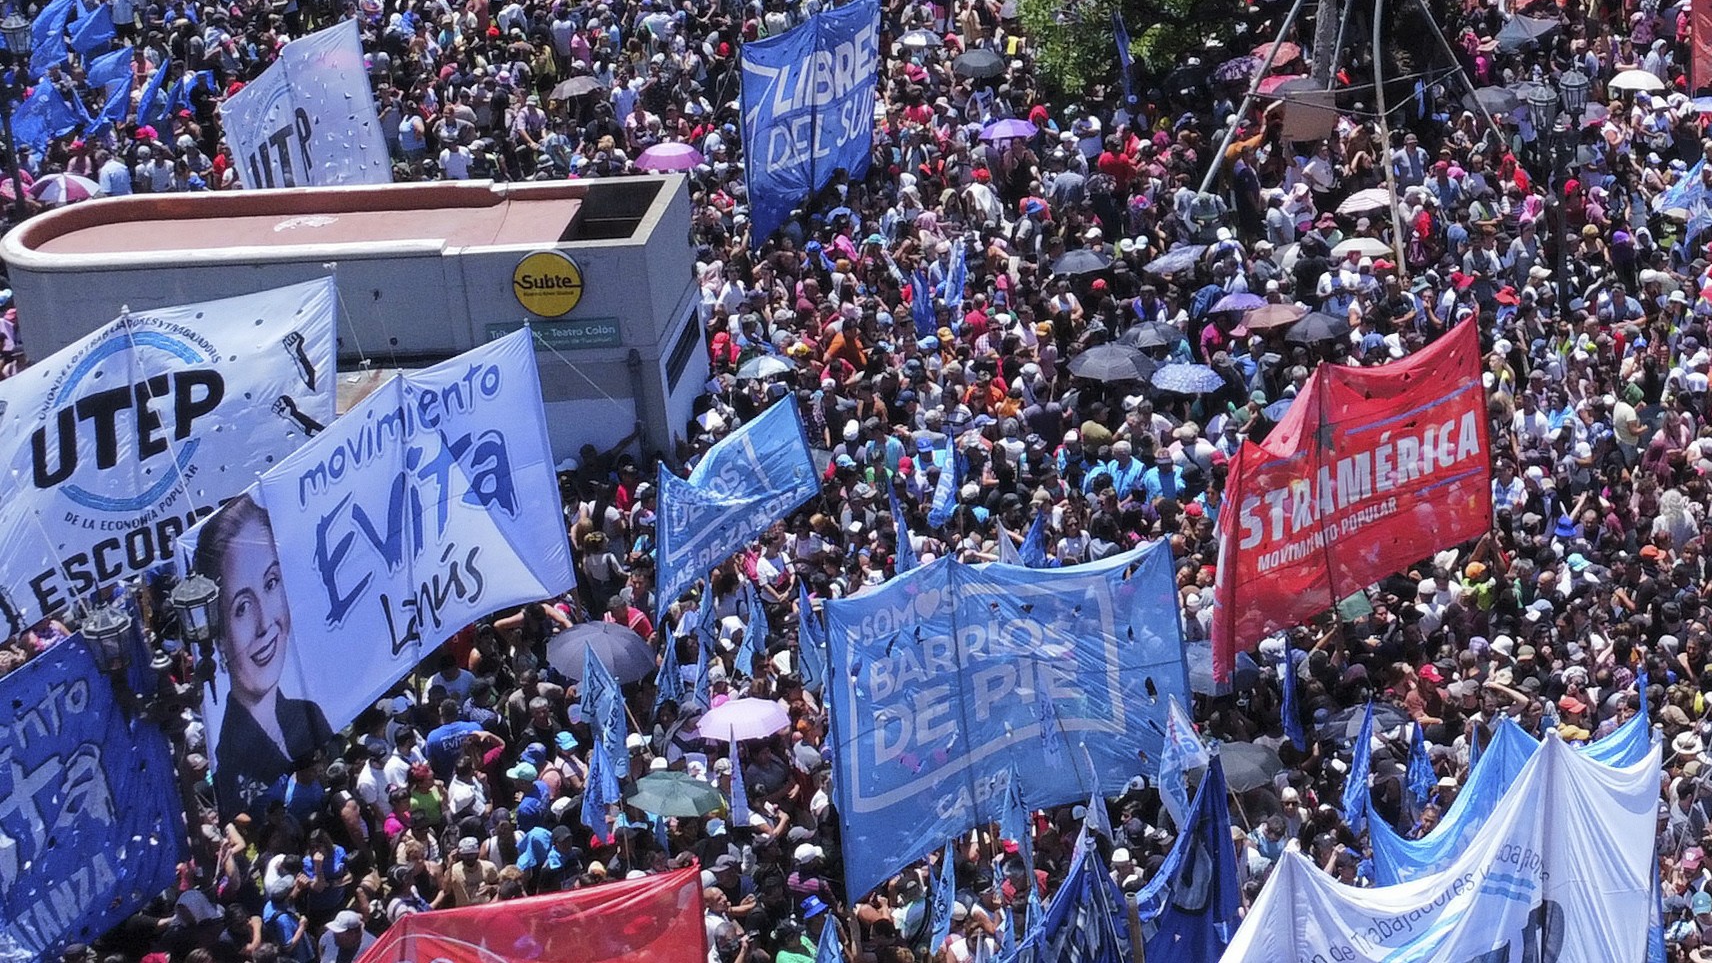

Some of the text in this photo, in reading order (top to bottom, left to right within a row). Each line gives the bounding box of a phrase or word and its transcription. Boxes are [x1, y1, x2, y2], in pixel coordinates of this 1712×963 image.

[772, 10, 881, 118] LIBRES
[767, 113, 831, 175] DEL
[522, 274, 573, 290] Subte
[551, 327, 583, 338] Teatro
[585, 324, 616, 336] Colón
[31, 368, 225, 489] UTEP
[299, 360, 502, 508] movimiento
[64, 511, 79, 525] DE
[82, 517, 95, 531] LA
[1339, 496, 1399, 534] POPULAR
[868, 615, 1079, 703] BARRIOS
[873, 655, 1081, 767] DE PIE
